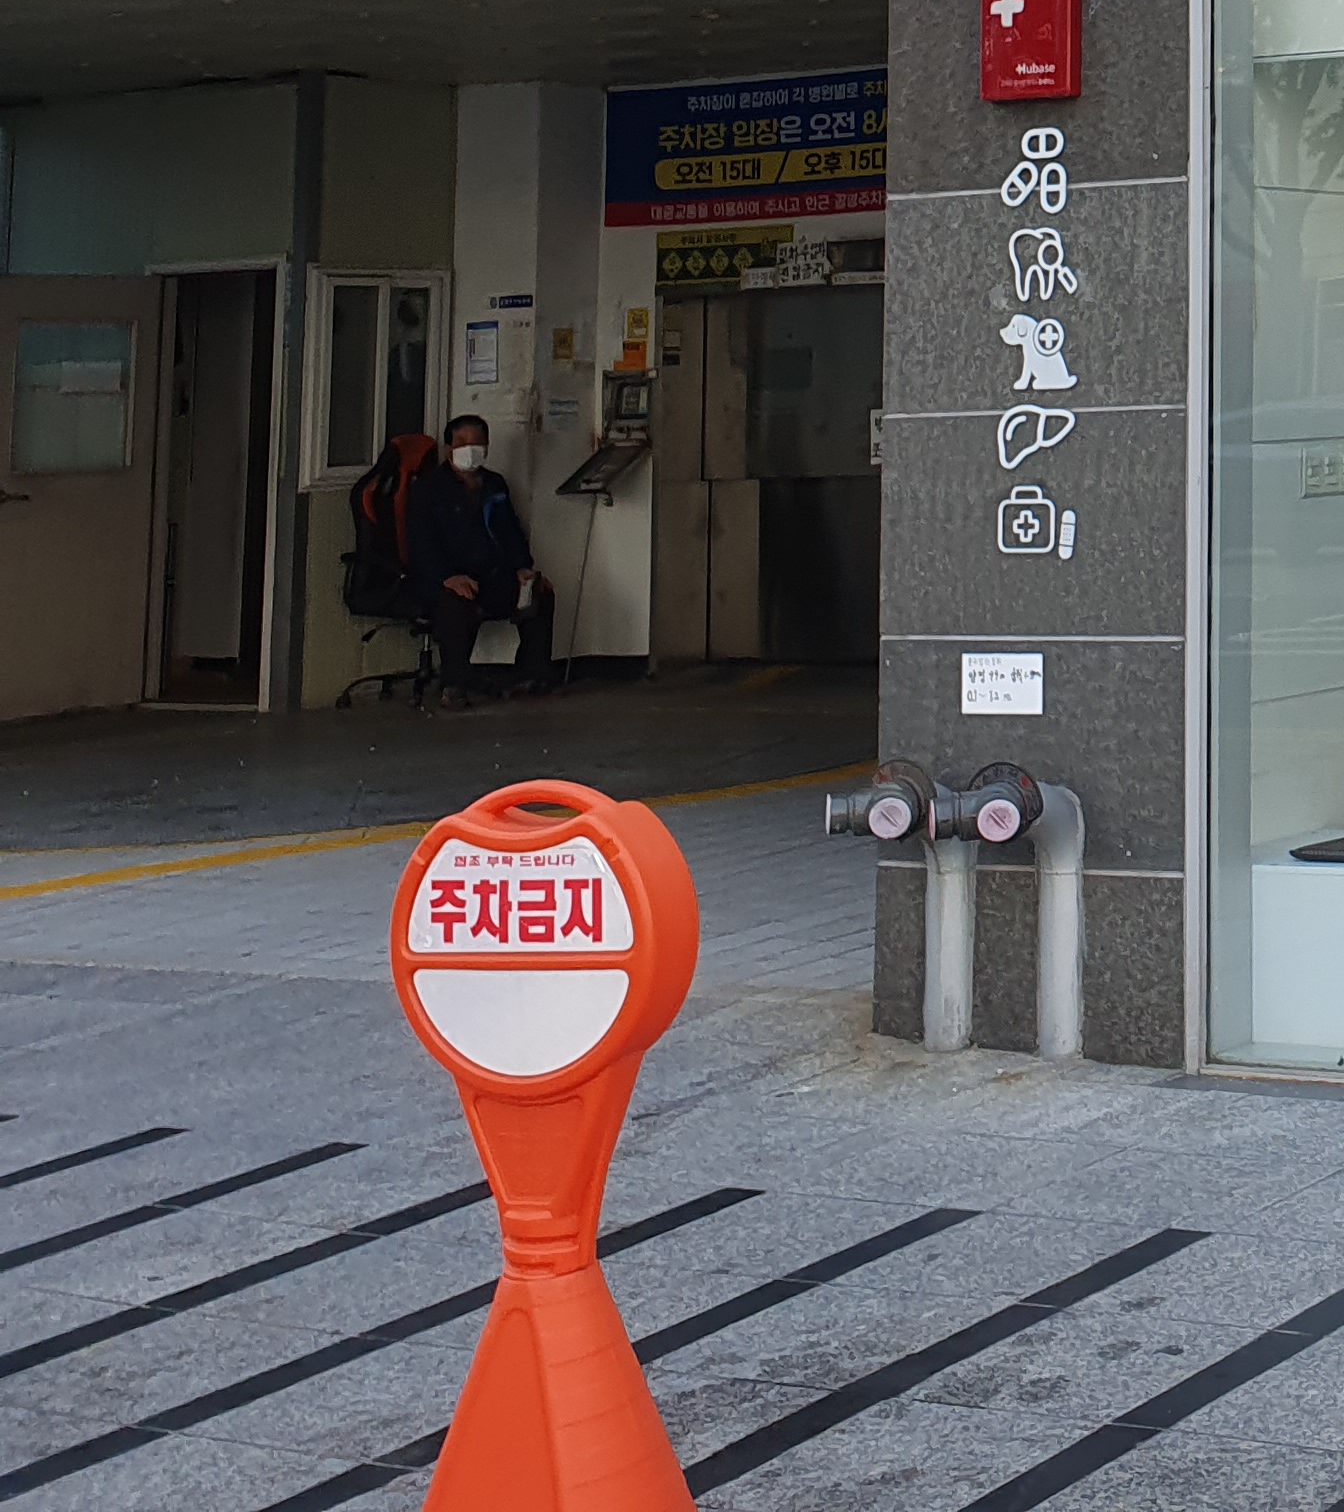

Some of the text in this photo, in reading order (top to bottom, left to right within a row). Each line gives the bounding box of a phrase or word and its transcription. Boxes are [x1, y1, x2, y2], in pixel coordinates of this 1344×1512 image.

[808, 110, 856, 141] 오전
[673, 160, 713, 184] 오전
[719, 157, 761, 181] 15대
[803, 151, 842, 175] 오후
[518, 853, 577, 868] 드립니다
[429, 877, 603, 945] 주차금지
